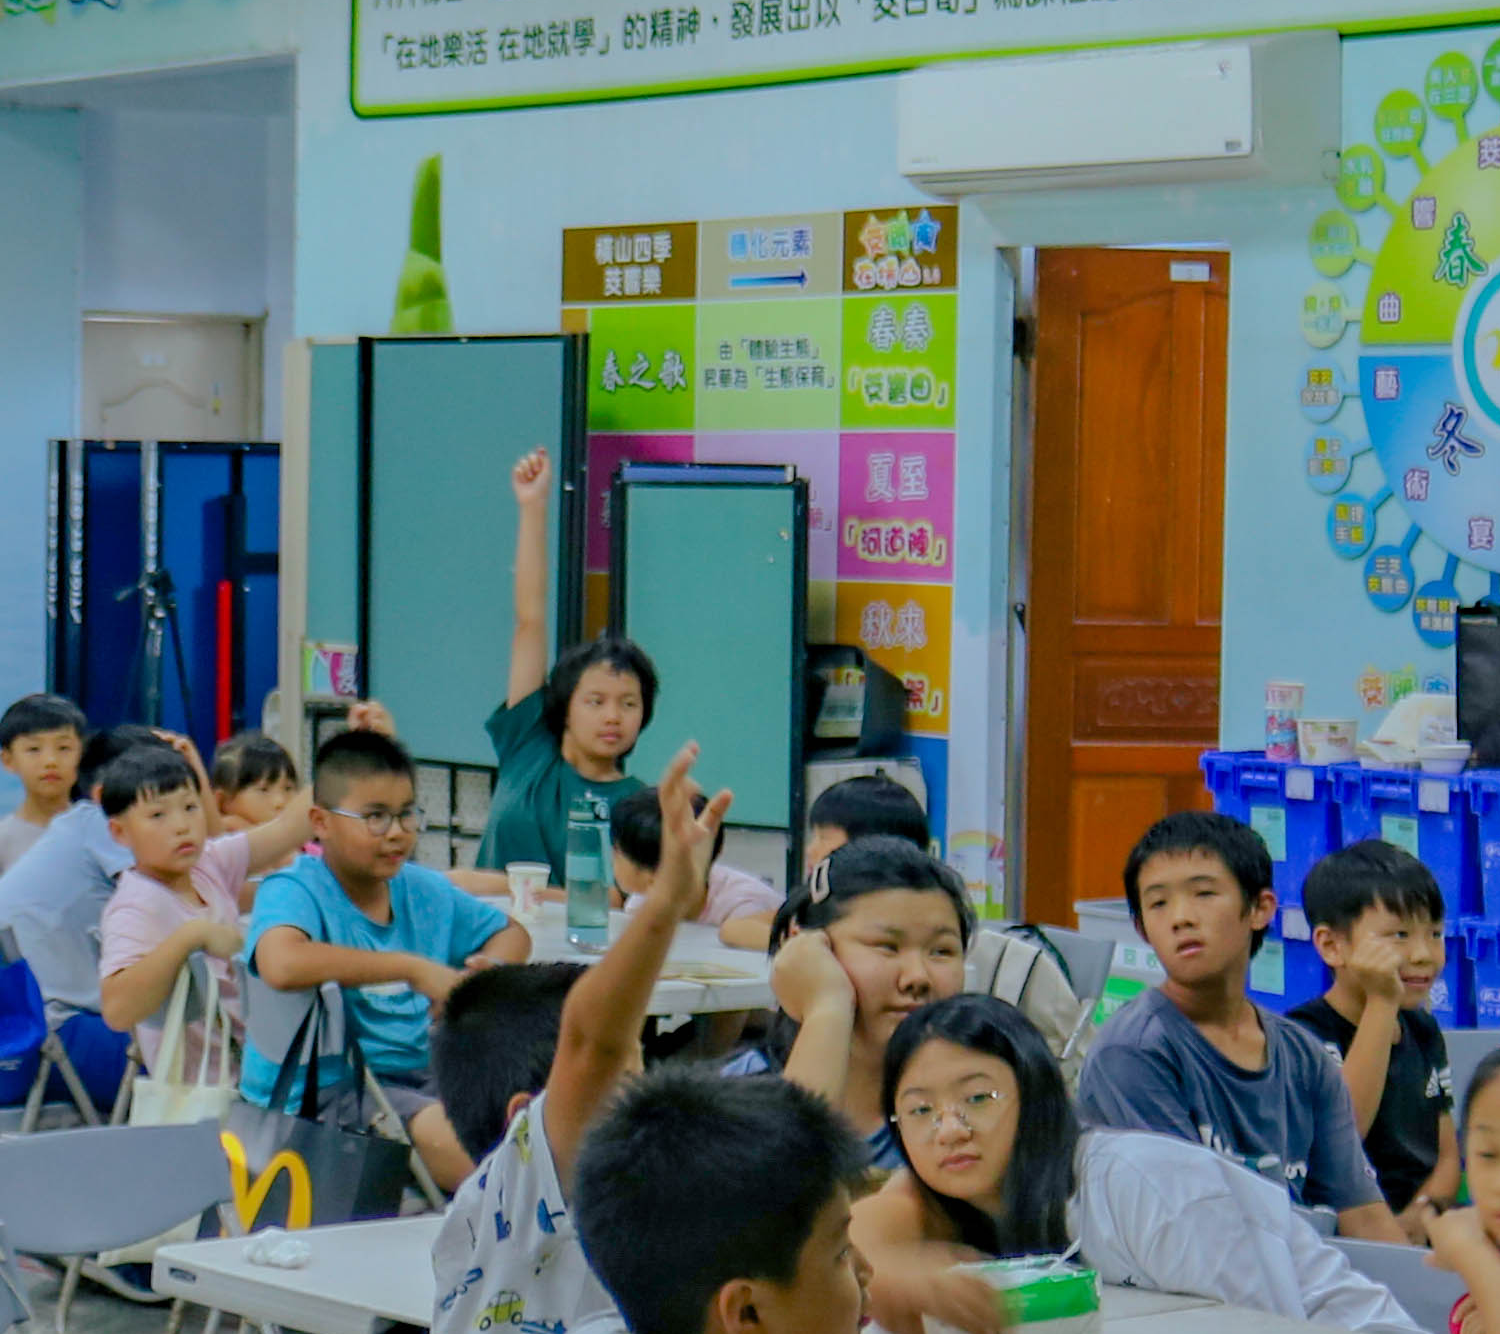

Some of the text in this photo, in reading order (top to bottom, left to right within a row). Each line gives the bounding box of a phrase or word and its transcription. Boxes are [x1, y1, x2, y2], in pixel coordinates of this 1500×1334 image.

[1434, 212, 1489, 288] 春
[1426, 402, 1486, 475] 冬
[864, 452, 930, 503] 夏至
[861, 600, 927, 652] 秋來
